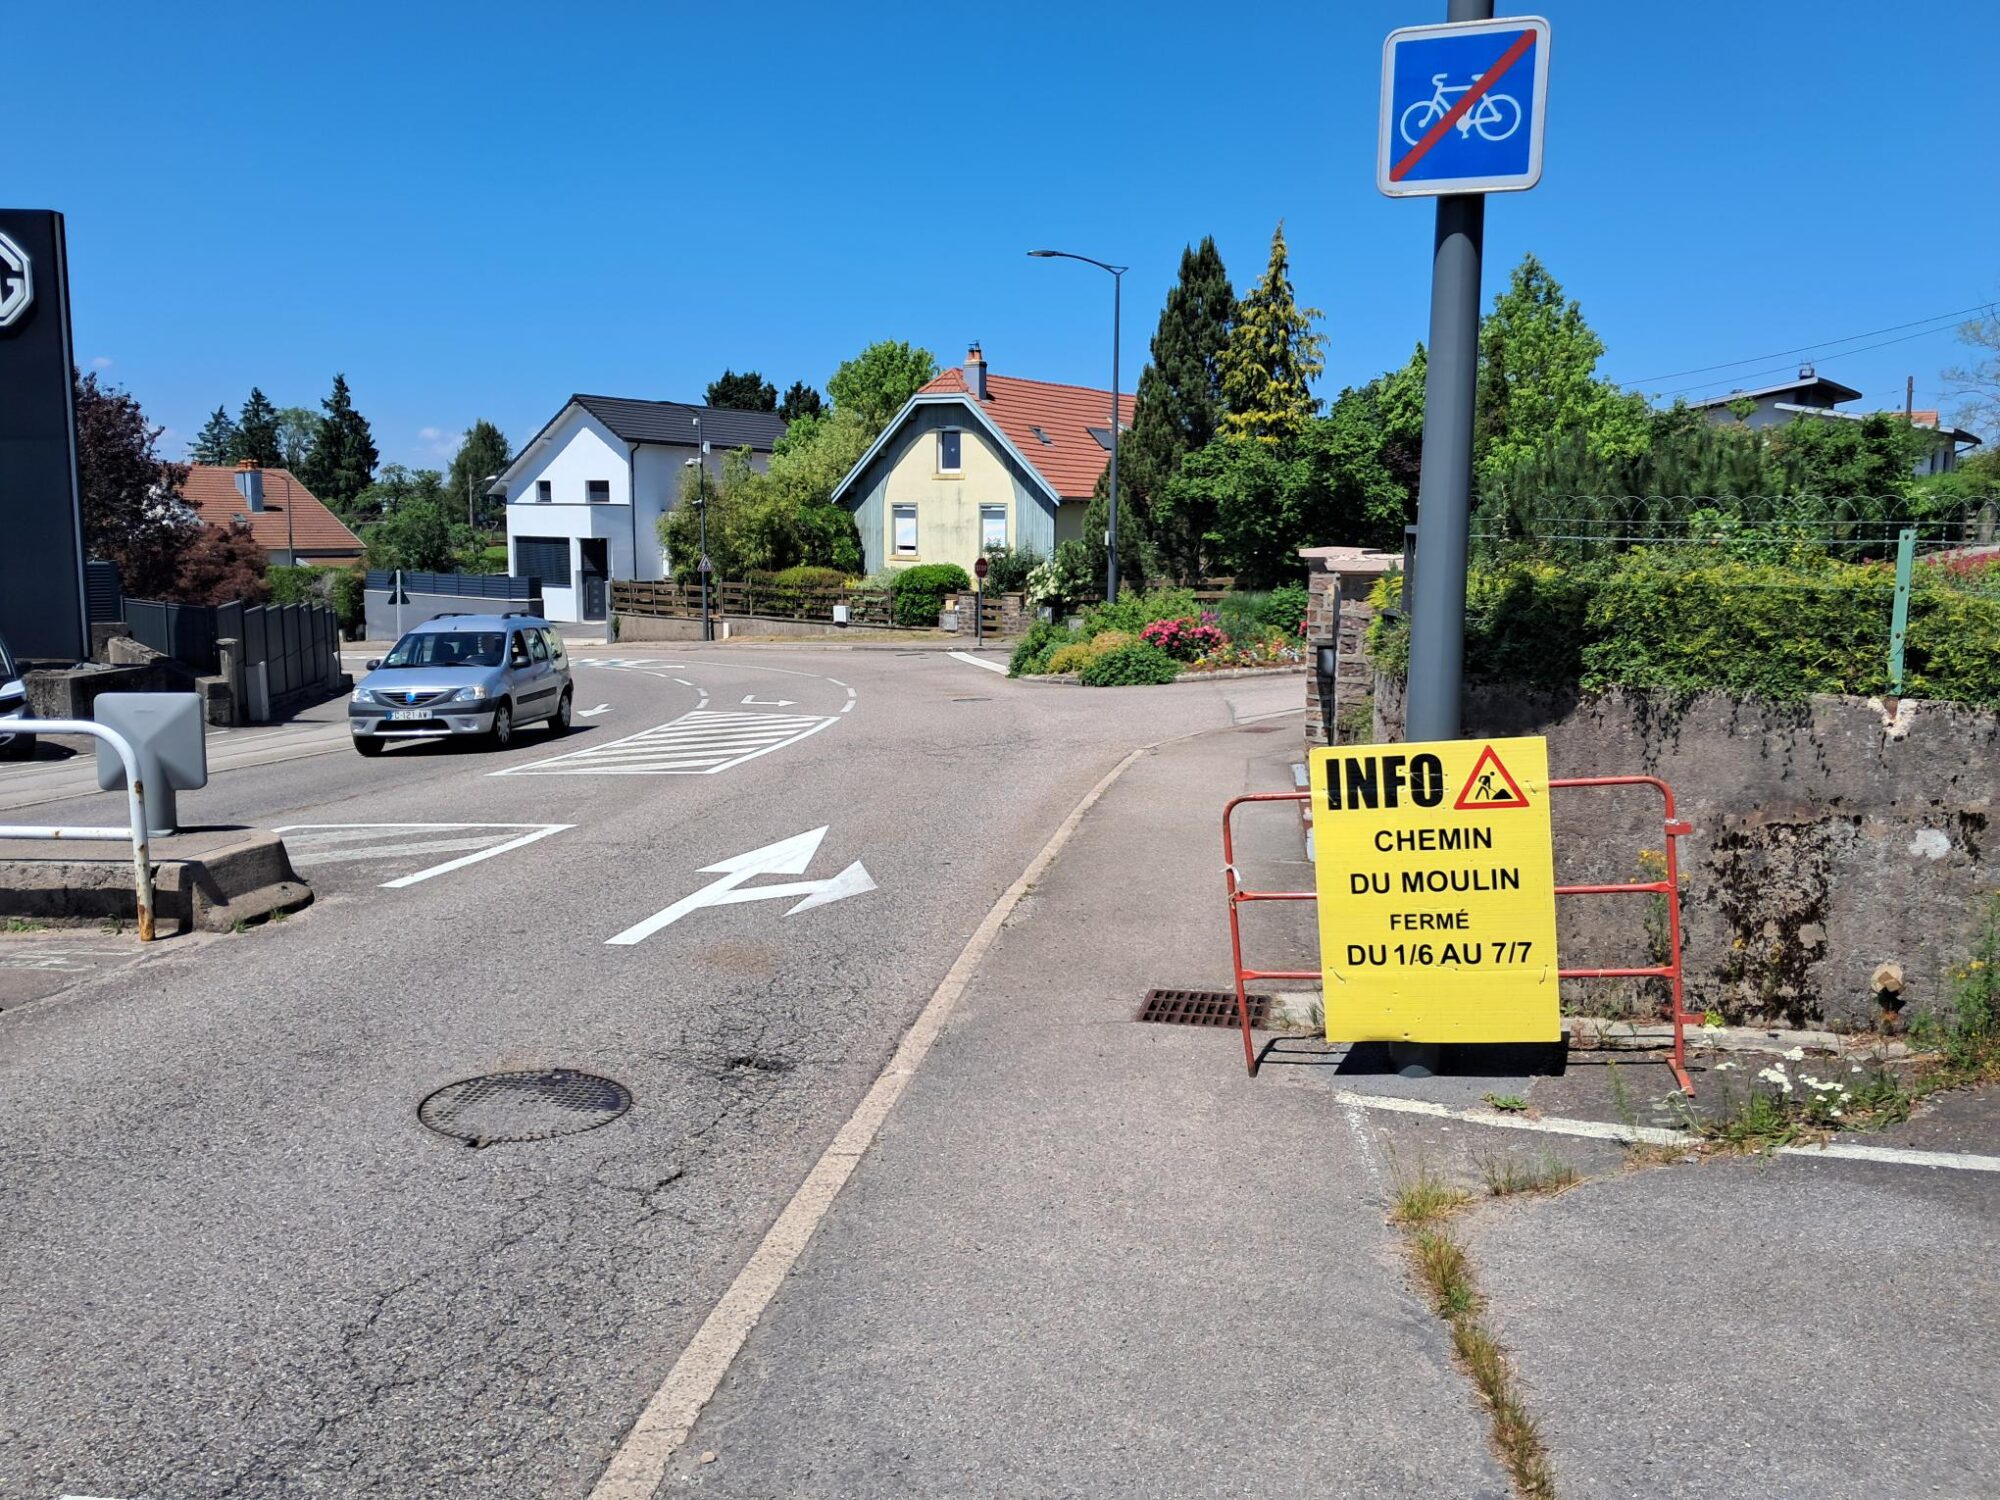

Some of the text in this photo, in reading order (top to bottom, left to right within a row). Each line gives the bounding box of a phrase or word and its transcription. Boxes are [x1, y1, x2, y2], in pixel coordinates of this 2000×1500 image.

[1325, 753, 1444, 811] INFO
[1374, 827, 1492, 852] CHEMIN
[1350, 868, 1520, 895] DU MOULIN
[1390, 907, 1470, 930] FERMÉ
[1347, 941, 1532, 966] DU 1/6 AU 7/7
